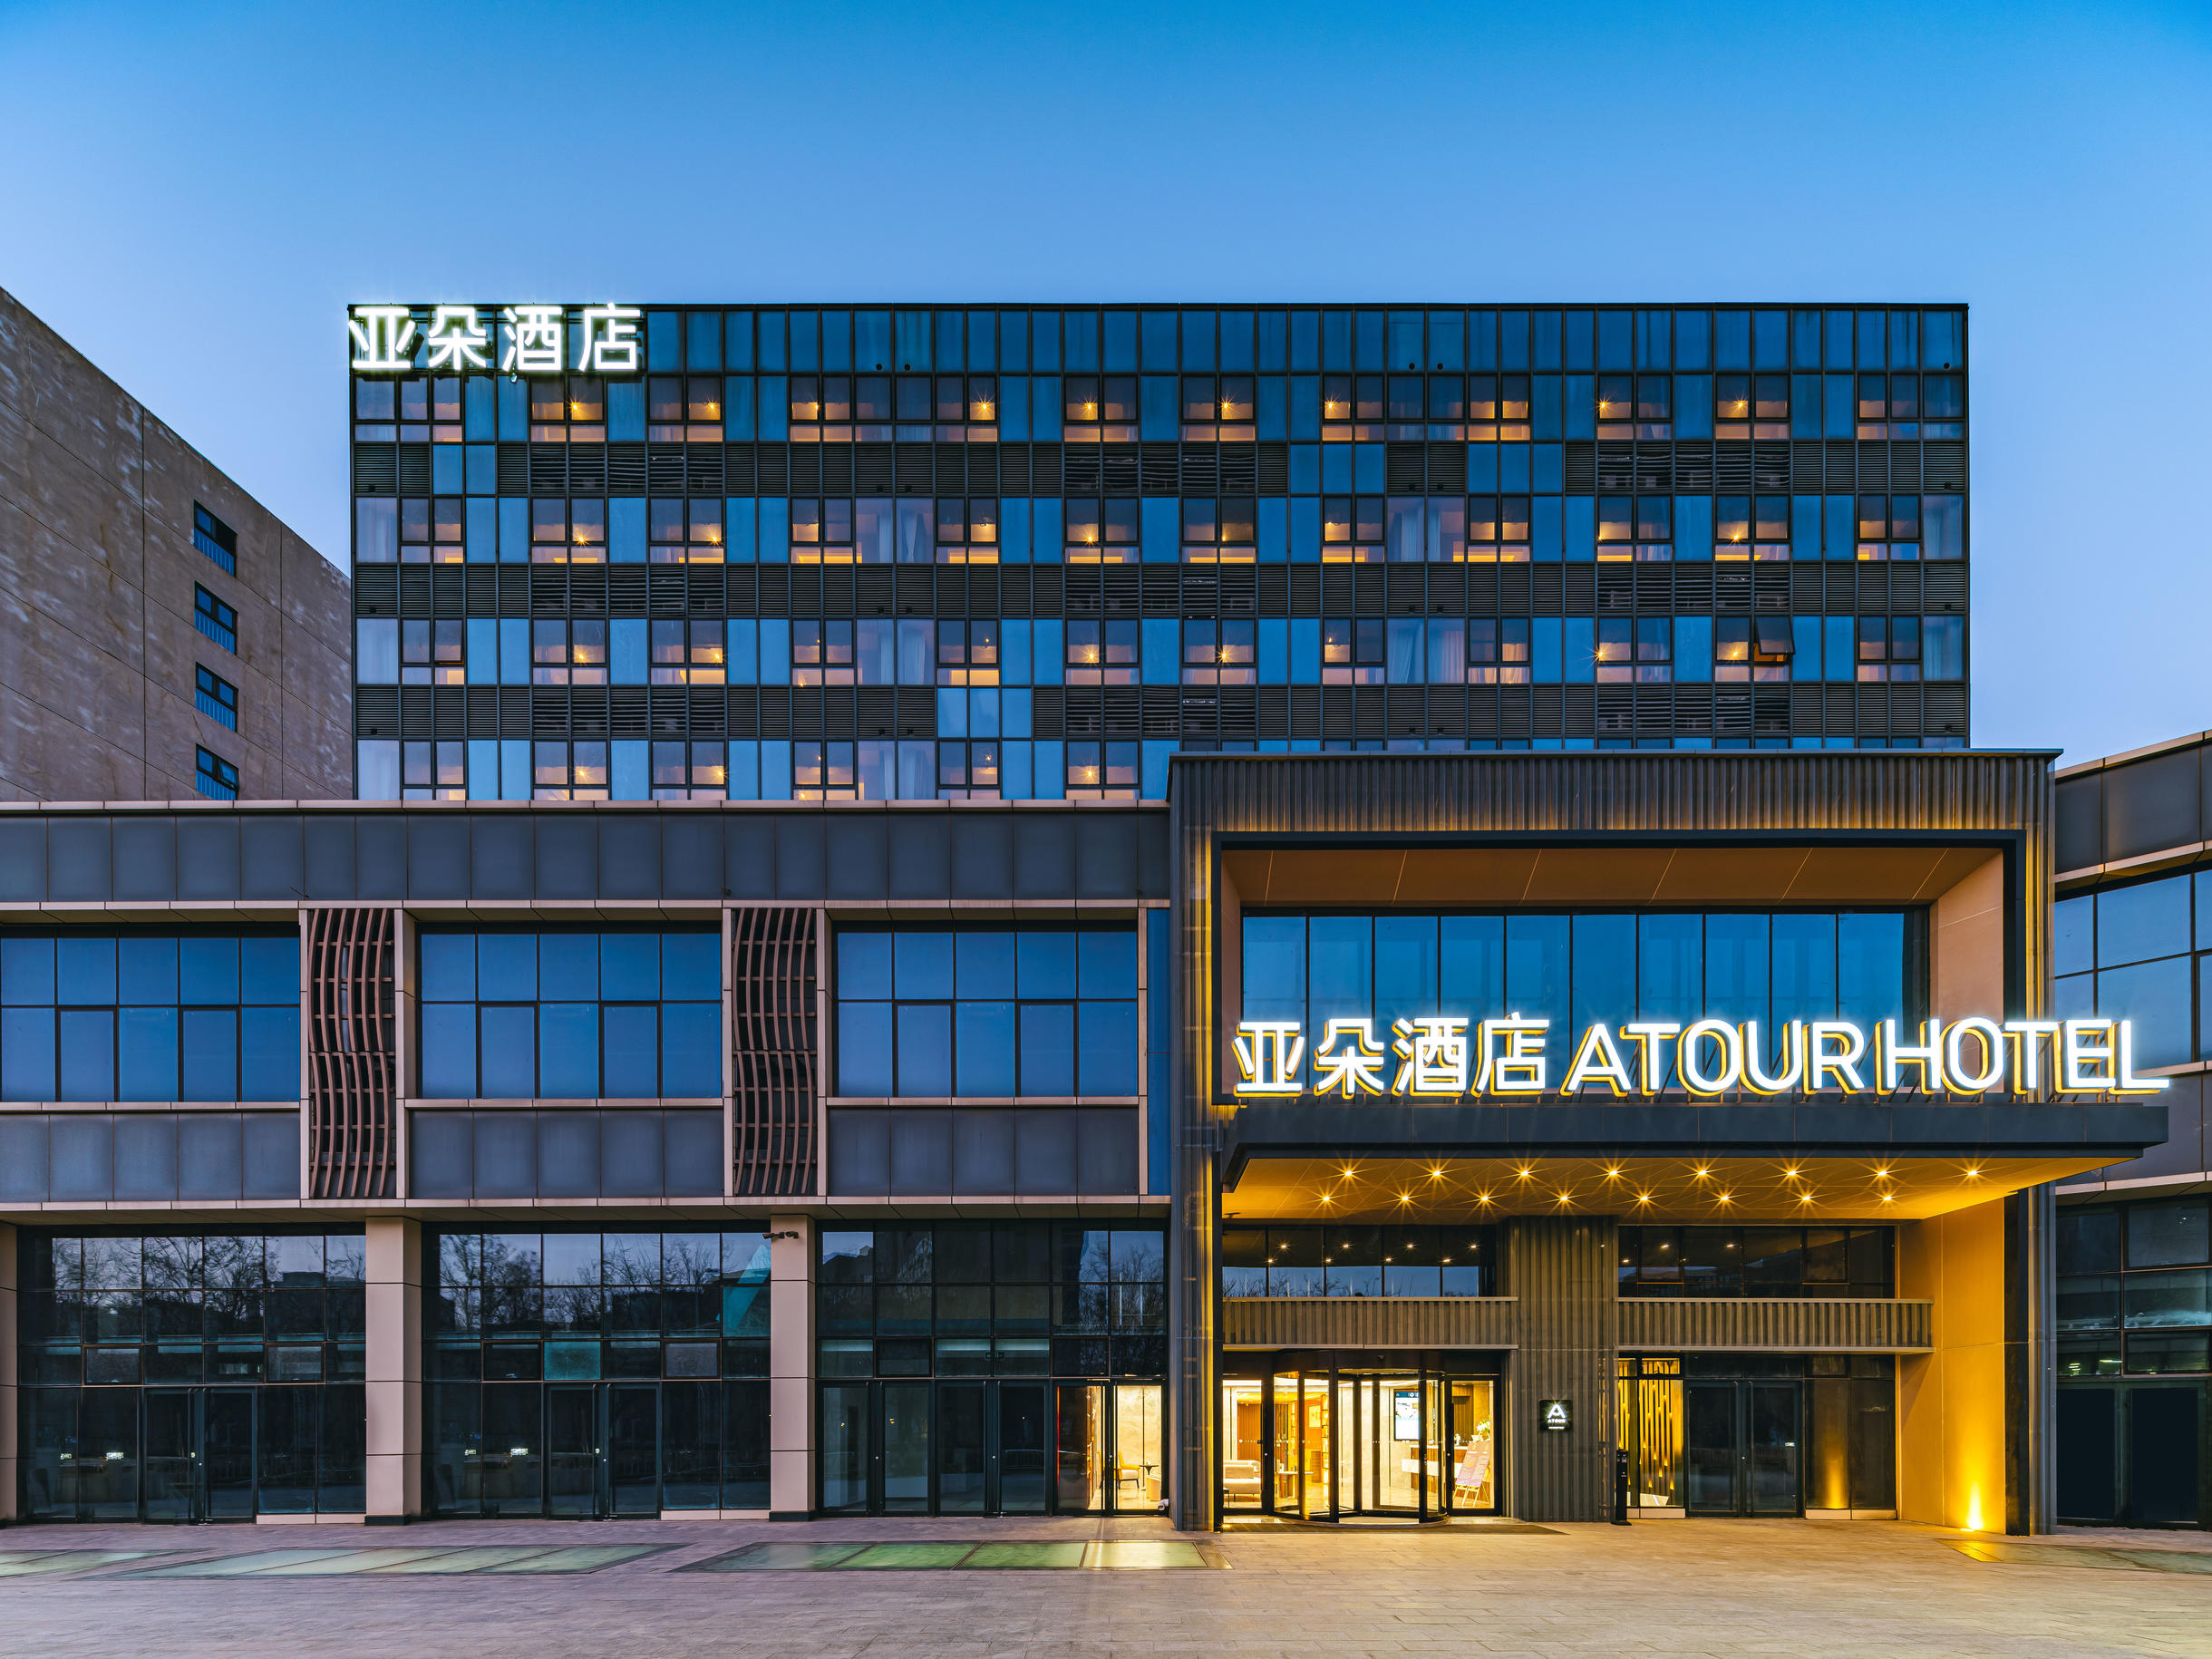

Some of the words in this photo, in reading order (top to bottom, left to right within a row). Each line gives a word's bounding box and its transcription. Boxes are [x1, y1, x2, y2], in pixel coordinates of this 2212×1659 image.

[348, 303, 642, 371] 亚朵酒店
[1233, 1012, 1550, 1096] 亚朵酒店
[1561, 1019, 1865, 1095] ATOUR
[1877, 1017, 2169, 1094] HOTEL
